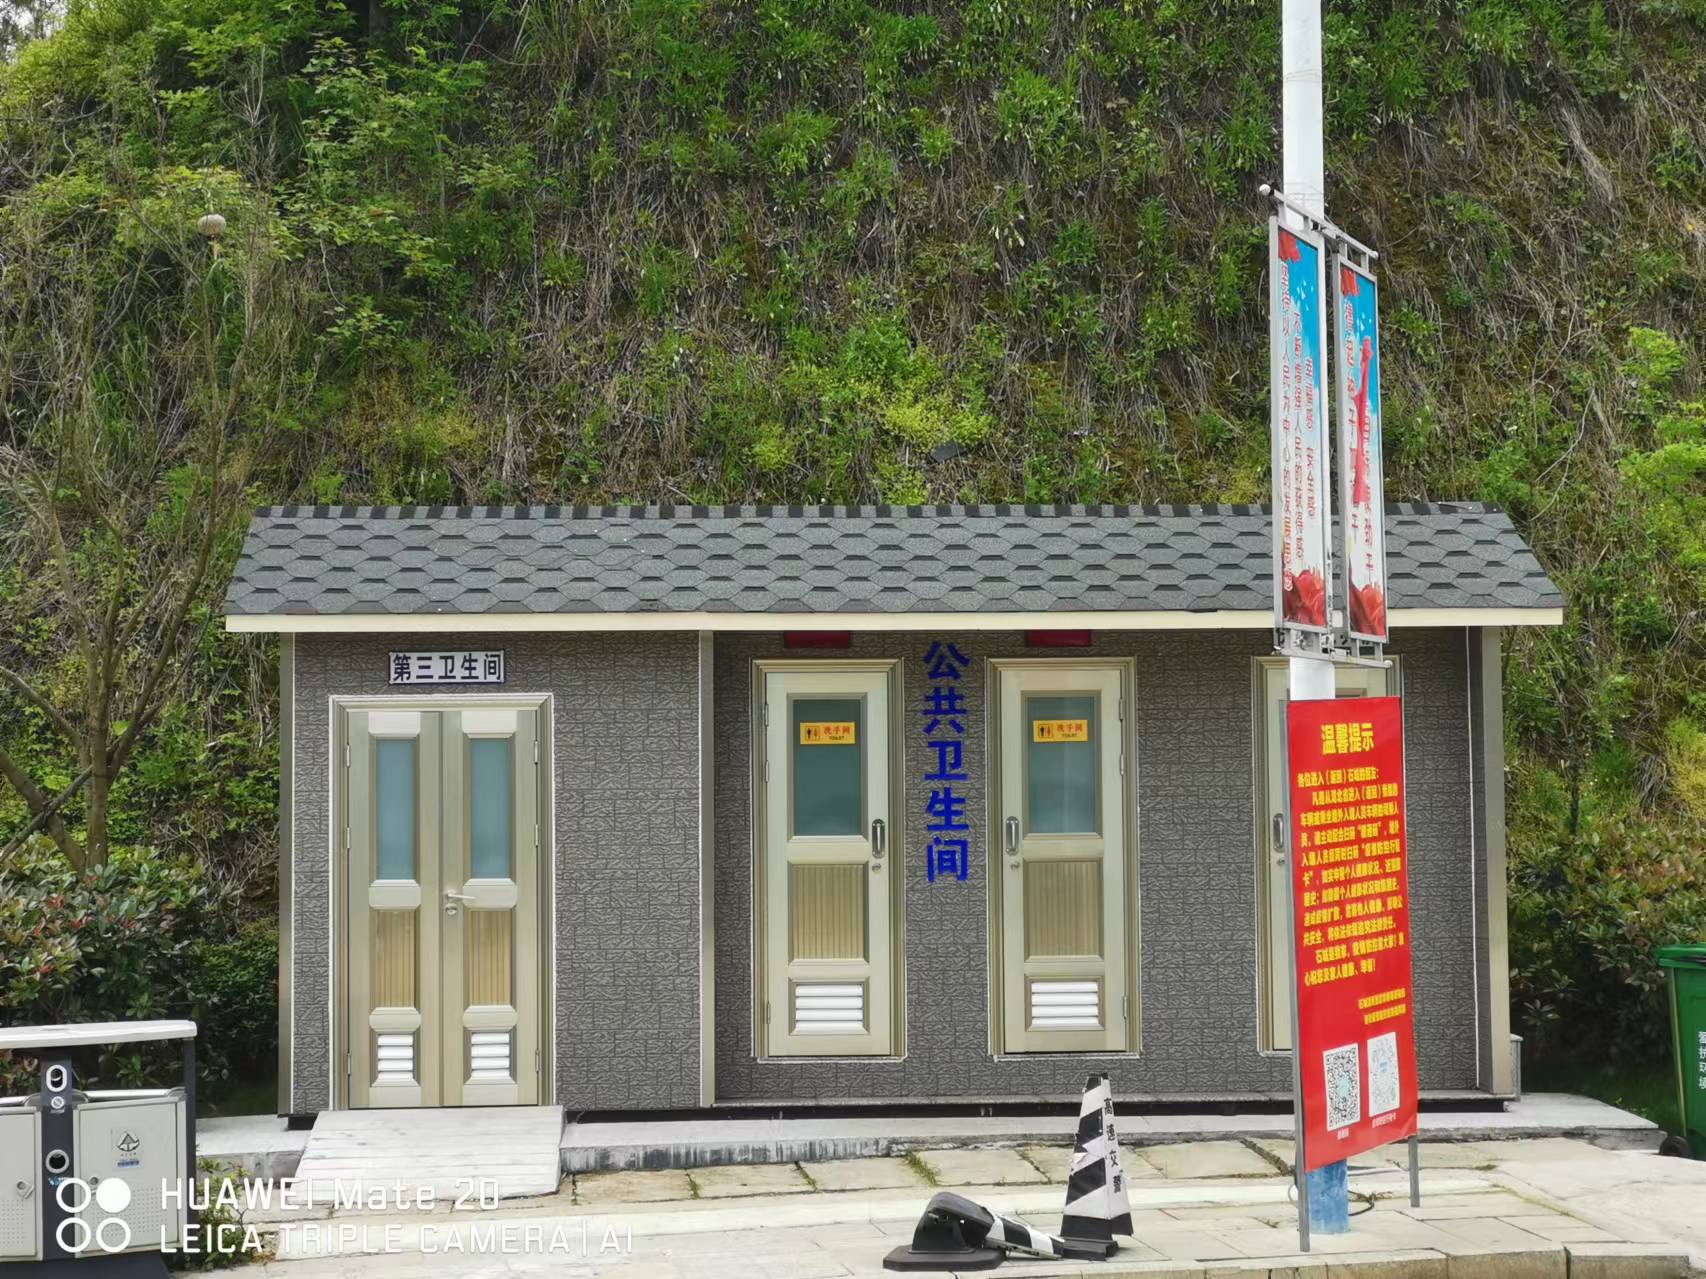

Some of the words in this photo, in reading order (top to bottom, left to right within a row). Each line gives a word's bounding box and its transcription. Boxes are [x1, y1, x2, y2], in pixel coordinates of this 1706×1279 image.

[393, 653, 501, 681] 第三卫生间
[1321, 723, 1374, 755] 温馨提示
[922, 640, 970, 882] 公共卫生间
